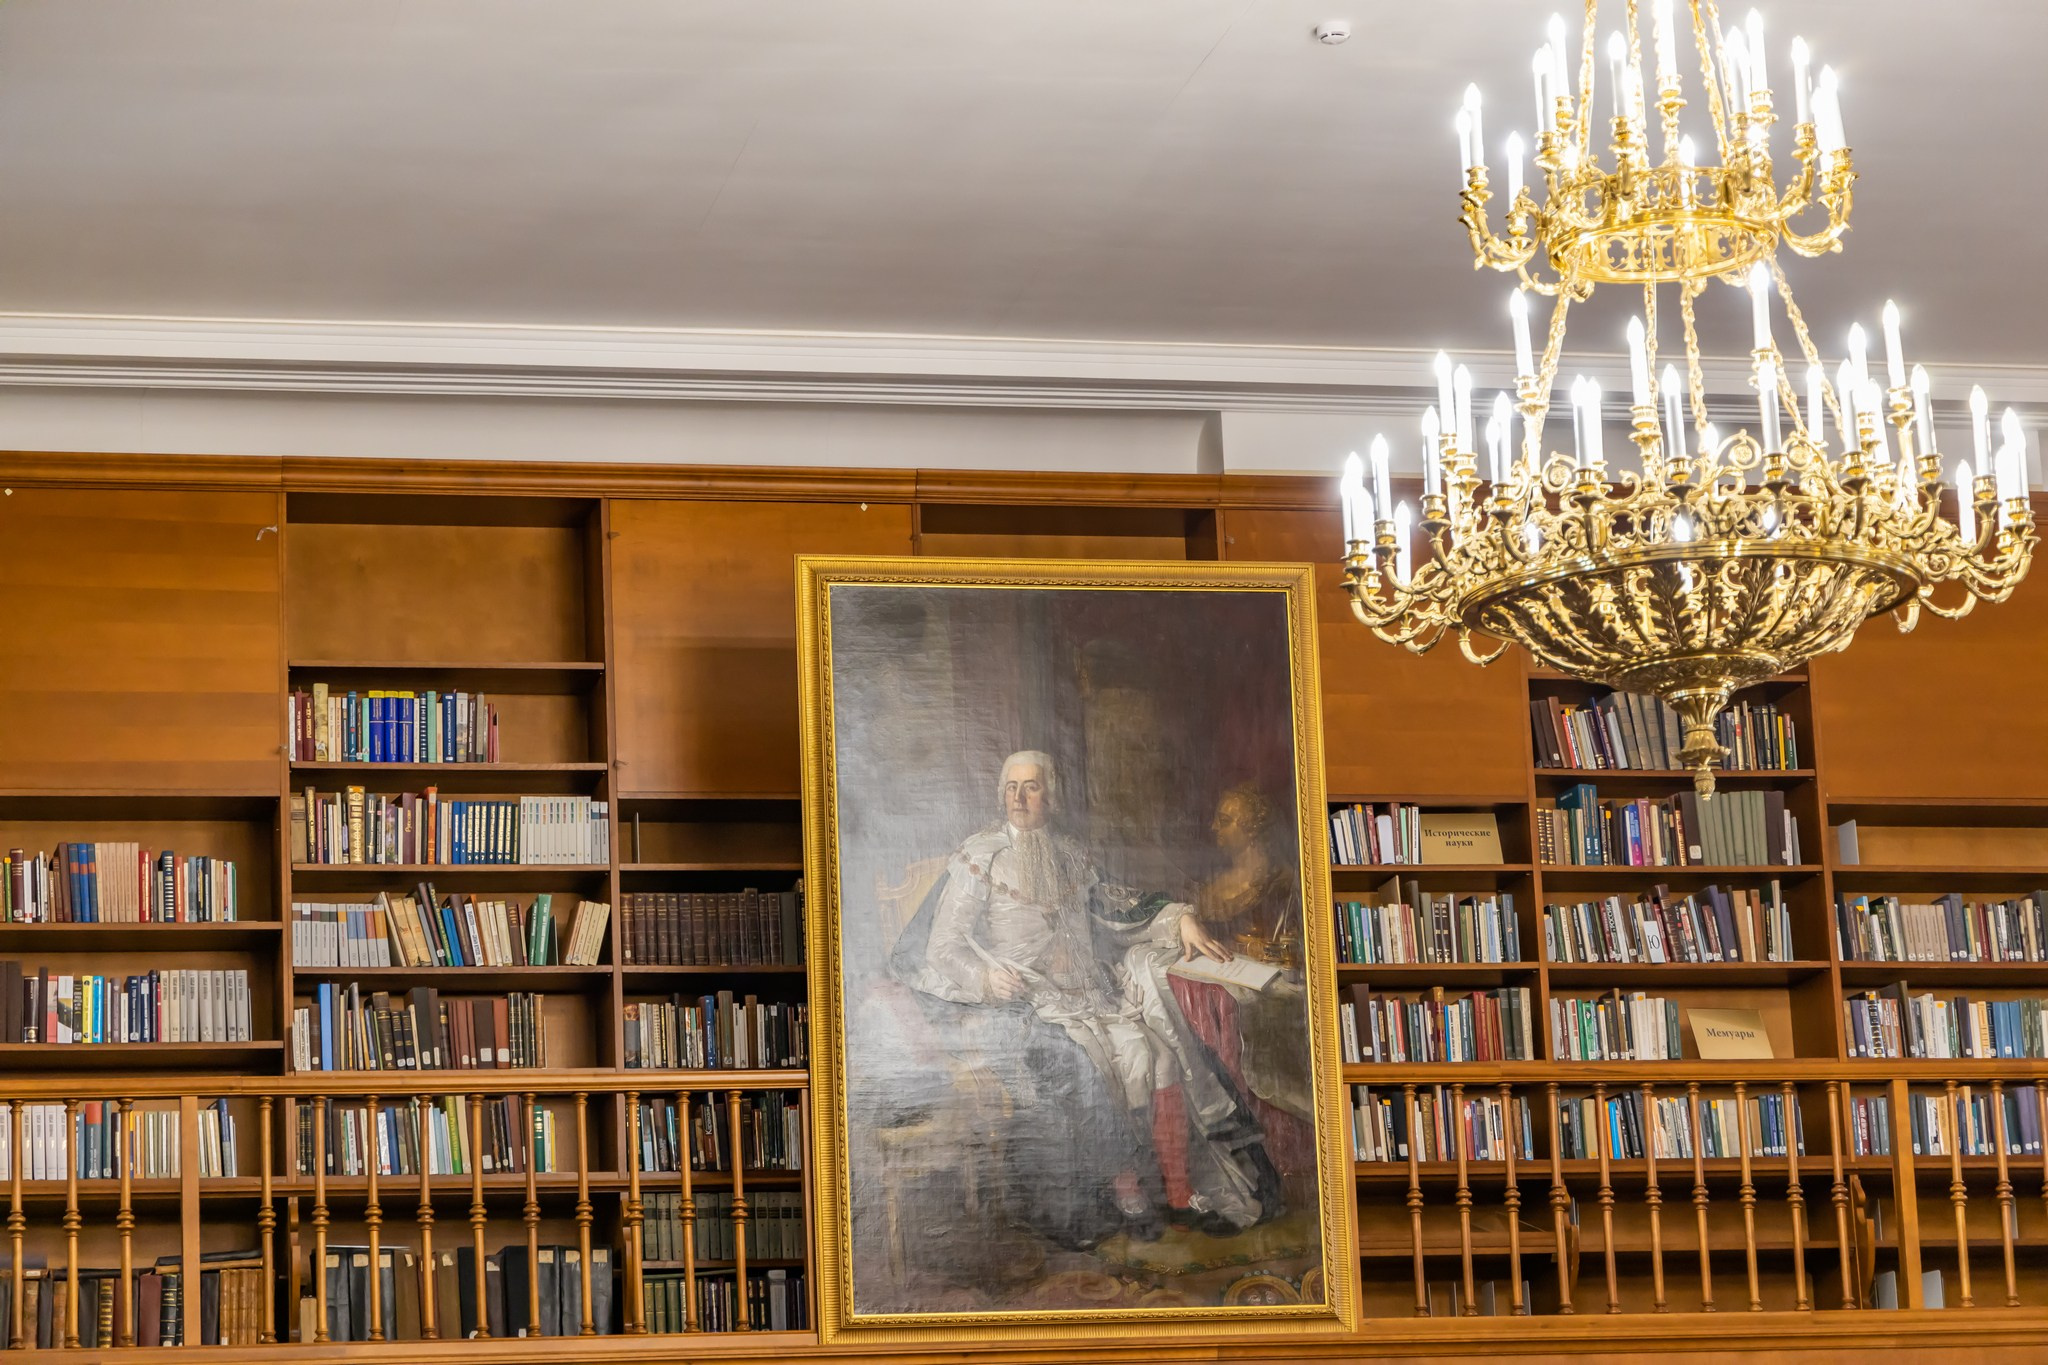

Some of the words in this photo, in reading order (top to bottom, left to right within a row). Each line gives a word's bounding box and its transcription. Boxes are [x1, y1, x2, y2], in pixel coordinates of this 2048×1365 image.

[1424, 829, 1491, 839] Исторические
[1445, 839, 1474, 848] науки
[1647, 934, 1660, 950] Ю
[1705, 1027, 1755, 1040] Мемуары
